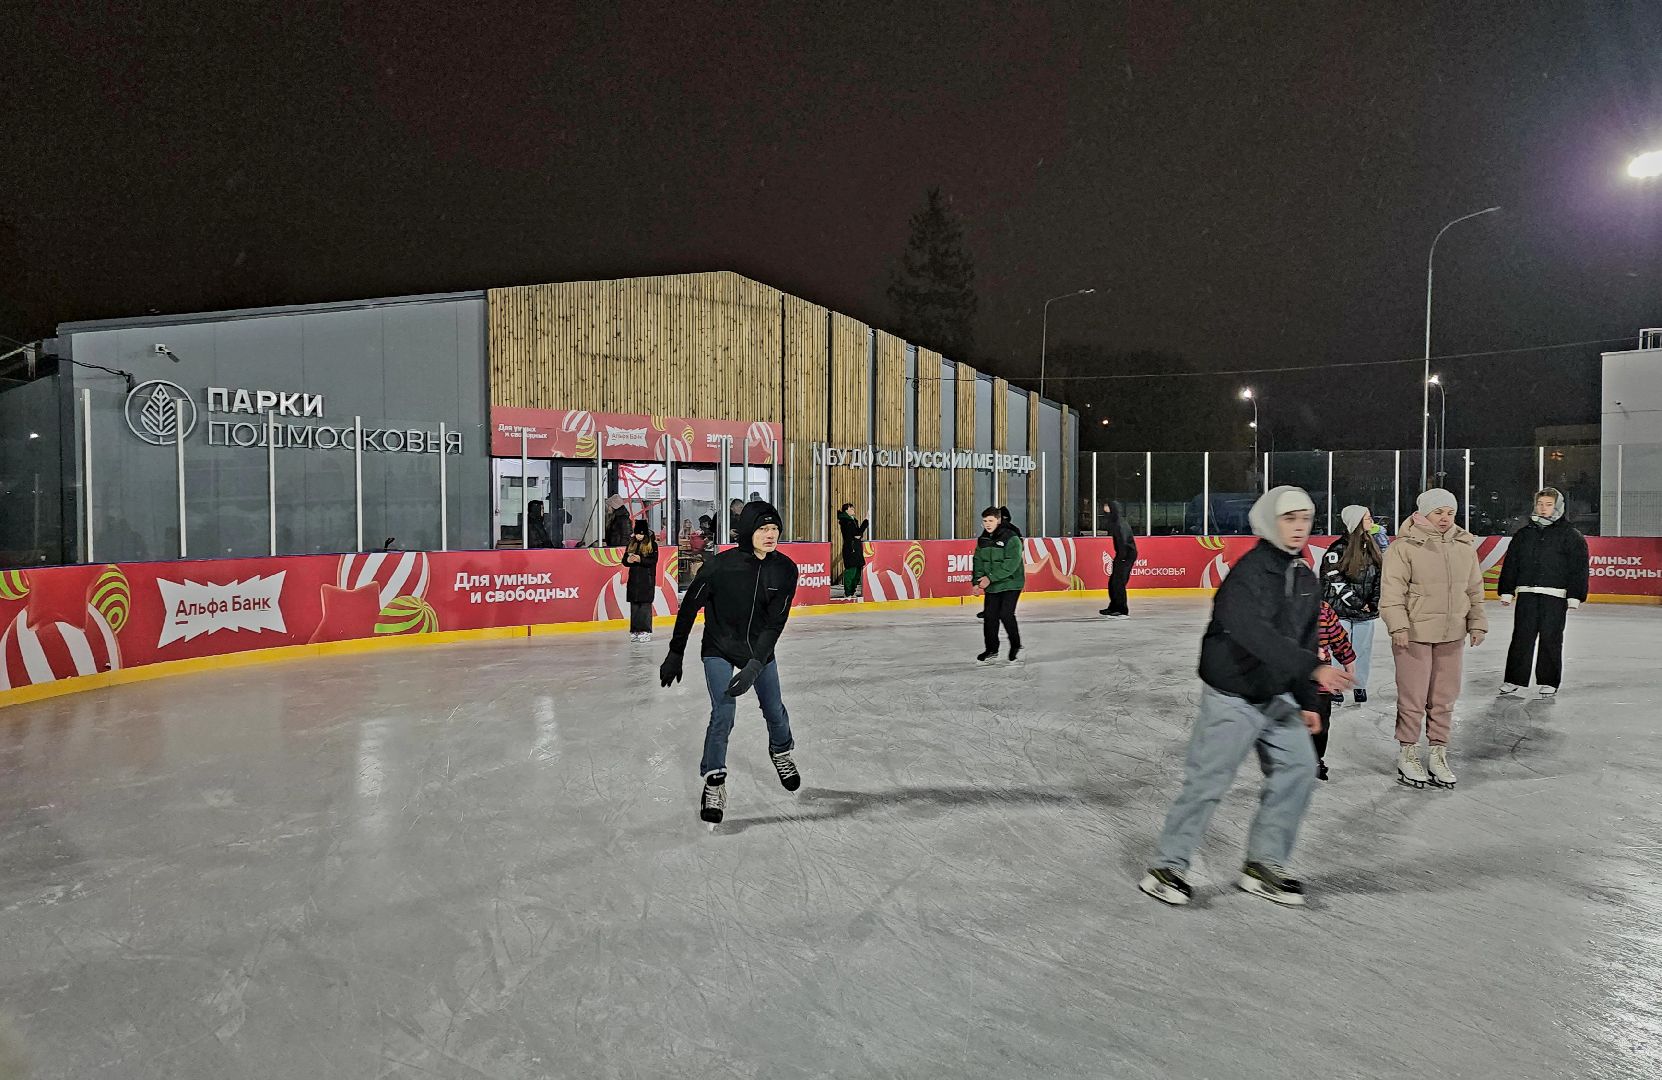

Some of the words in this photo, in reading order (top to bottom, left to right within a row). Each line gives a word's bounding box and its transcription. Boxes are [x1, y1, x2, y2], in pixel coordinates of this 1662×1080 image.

[207, 387, 323, 417] ПАРКИ
[208, 421, 462, 454] ПОДМОСКОВЬЯ
[510, 432, 548, 440] своодных
[973, 451, 1037, 474] МЕДВЕДЬ
[797, 563, 825, 574] ных
[1130, 567, 1186, 576] ДМОСКОВЬЯ
[1588, 565, 1662, 580] вободны
[454, 572, 490, 591] Для
[493, 572, 553, 590] умных
[470, 591, 482, 604] и
[485, 585, 580, 603] свободных
[175, 598, 228, 619] Альфа
[232, 595, 272, 612] Банк
